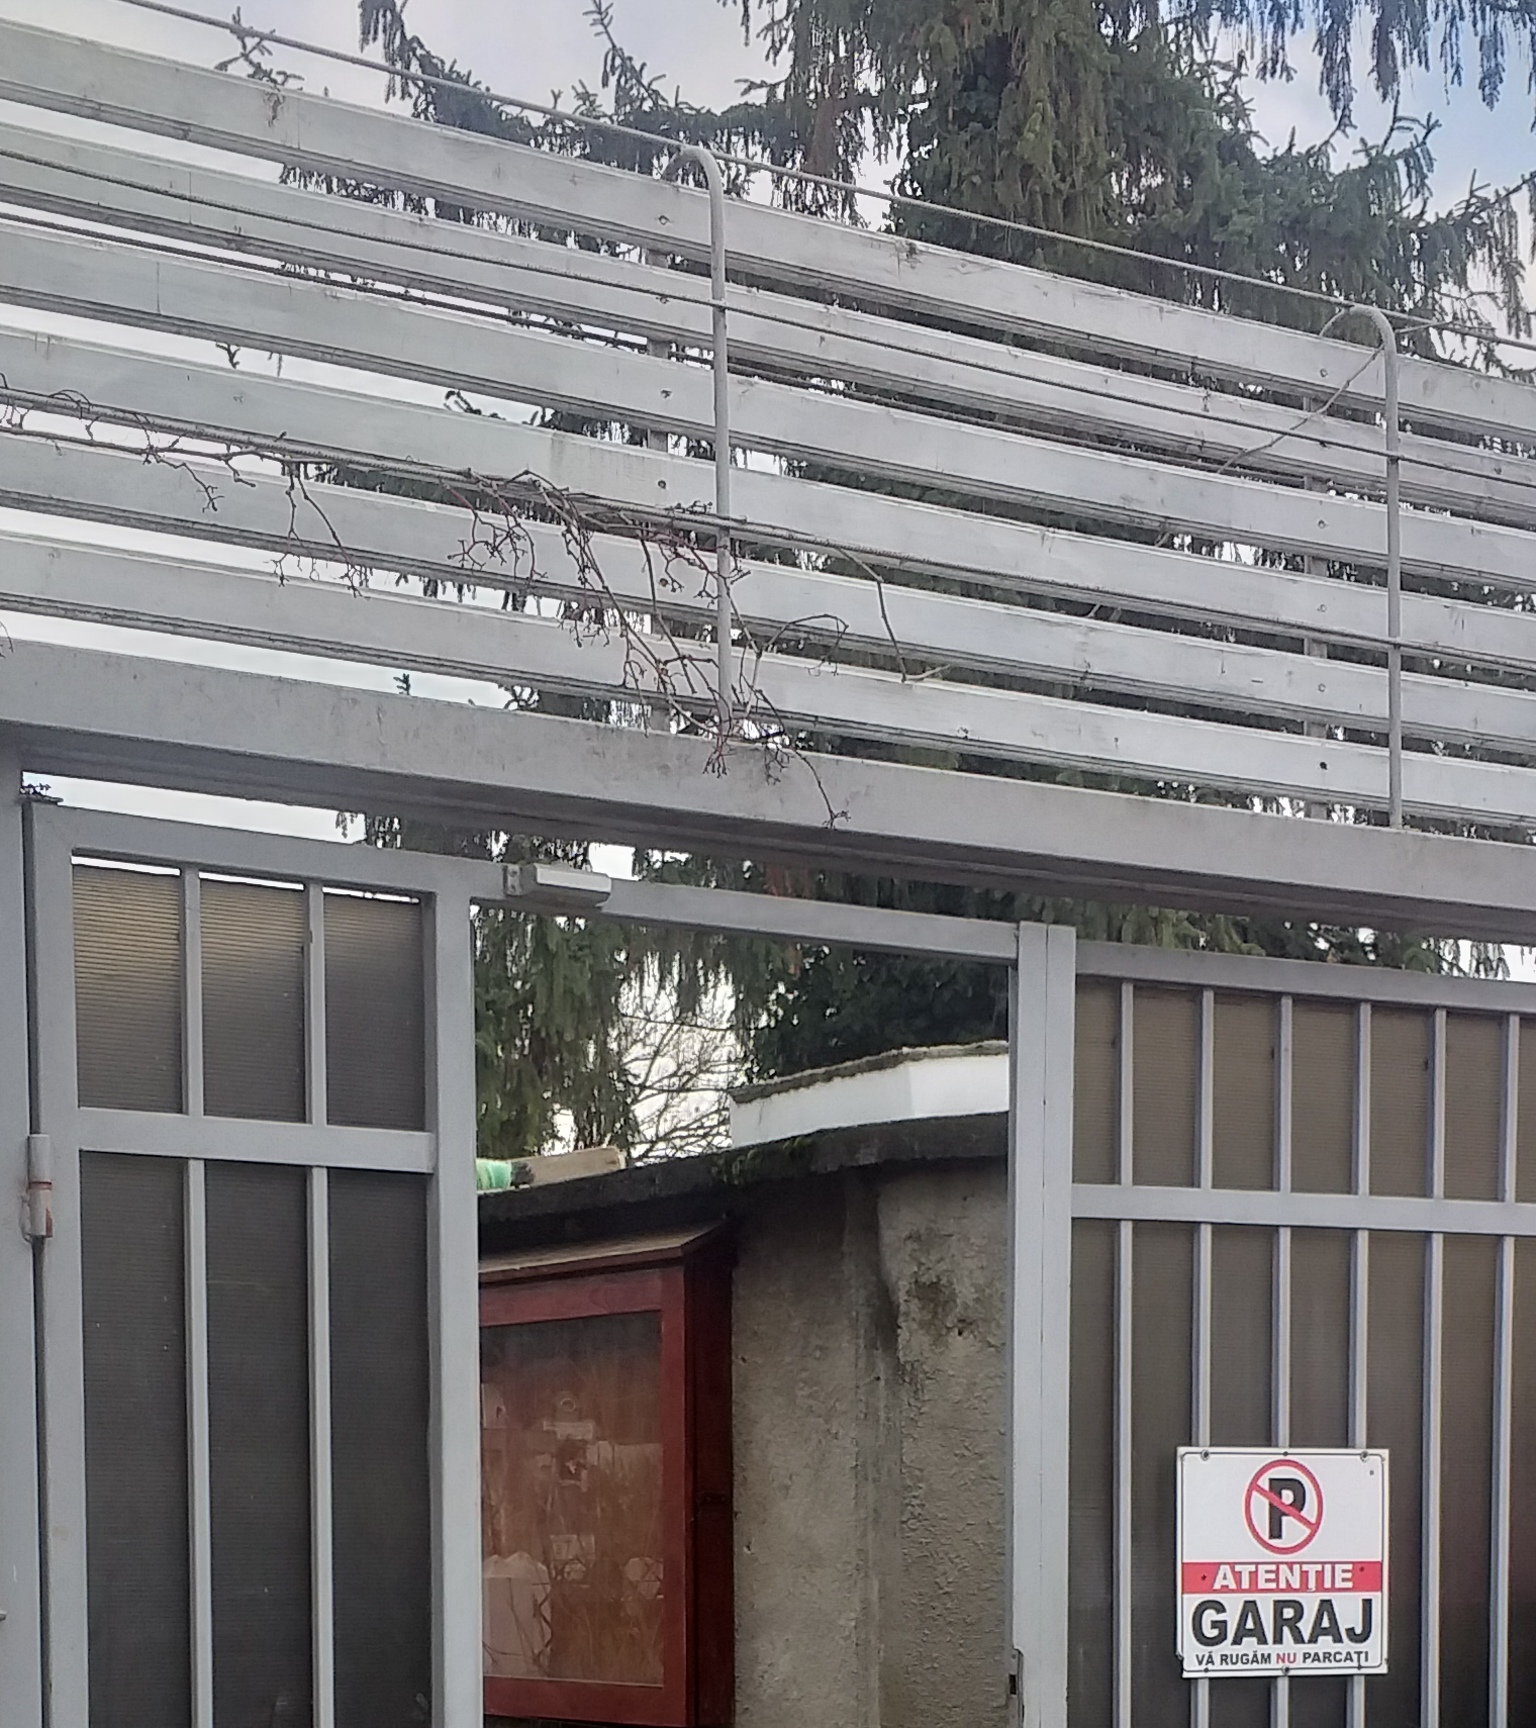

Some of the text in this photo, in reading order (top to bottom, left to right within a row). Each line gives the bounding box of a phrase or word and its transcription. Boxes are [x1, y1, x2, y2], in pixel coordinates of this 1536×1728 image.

[1267, 1477, 1307, 1540] P
[1191, 1597, 1374, 1647] GARAJ
[1220, 1650, 1272, 1666] RUGĂM
[1276, 1652, 1298, 1665] NU
